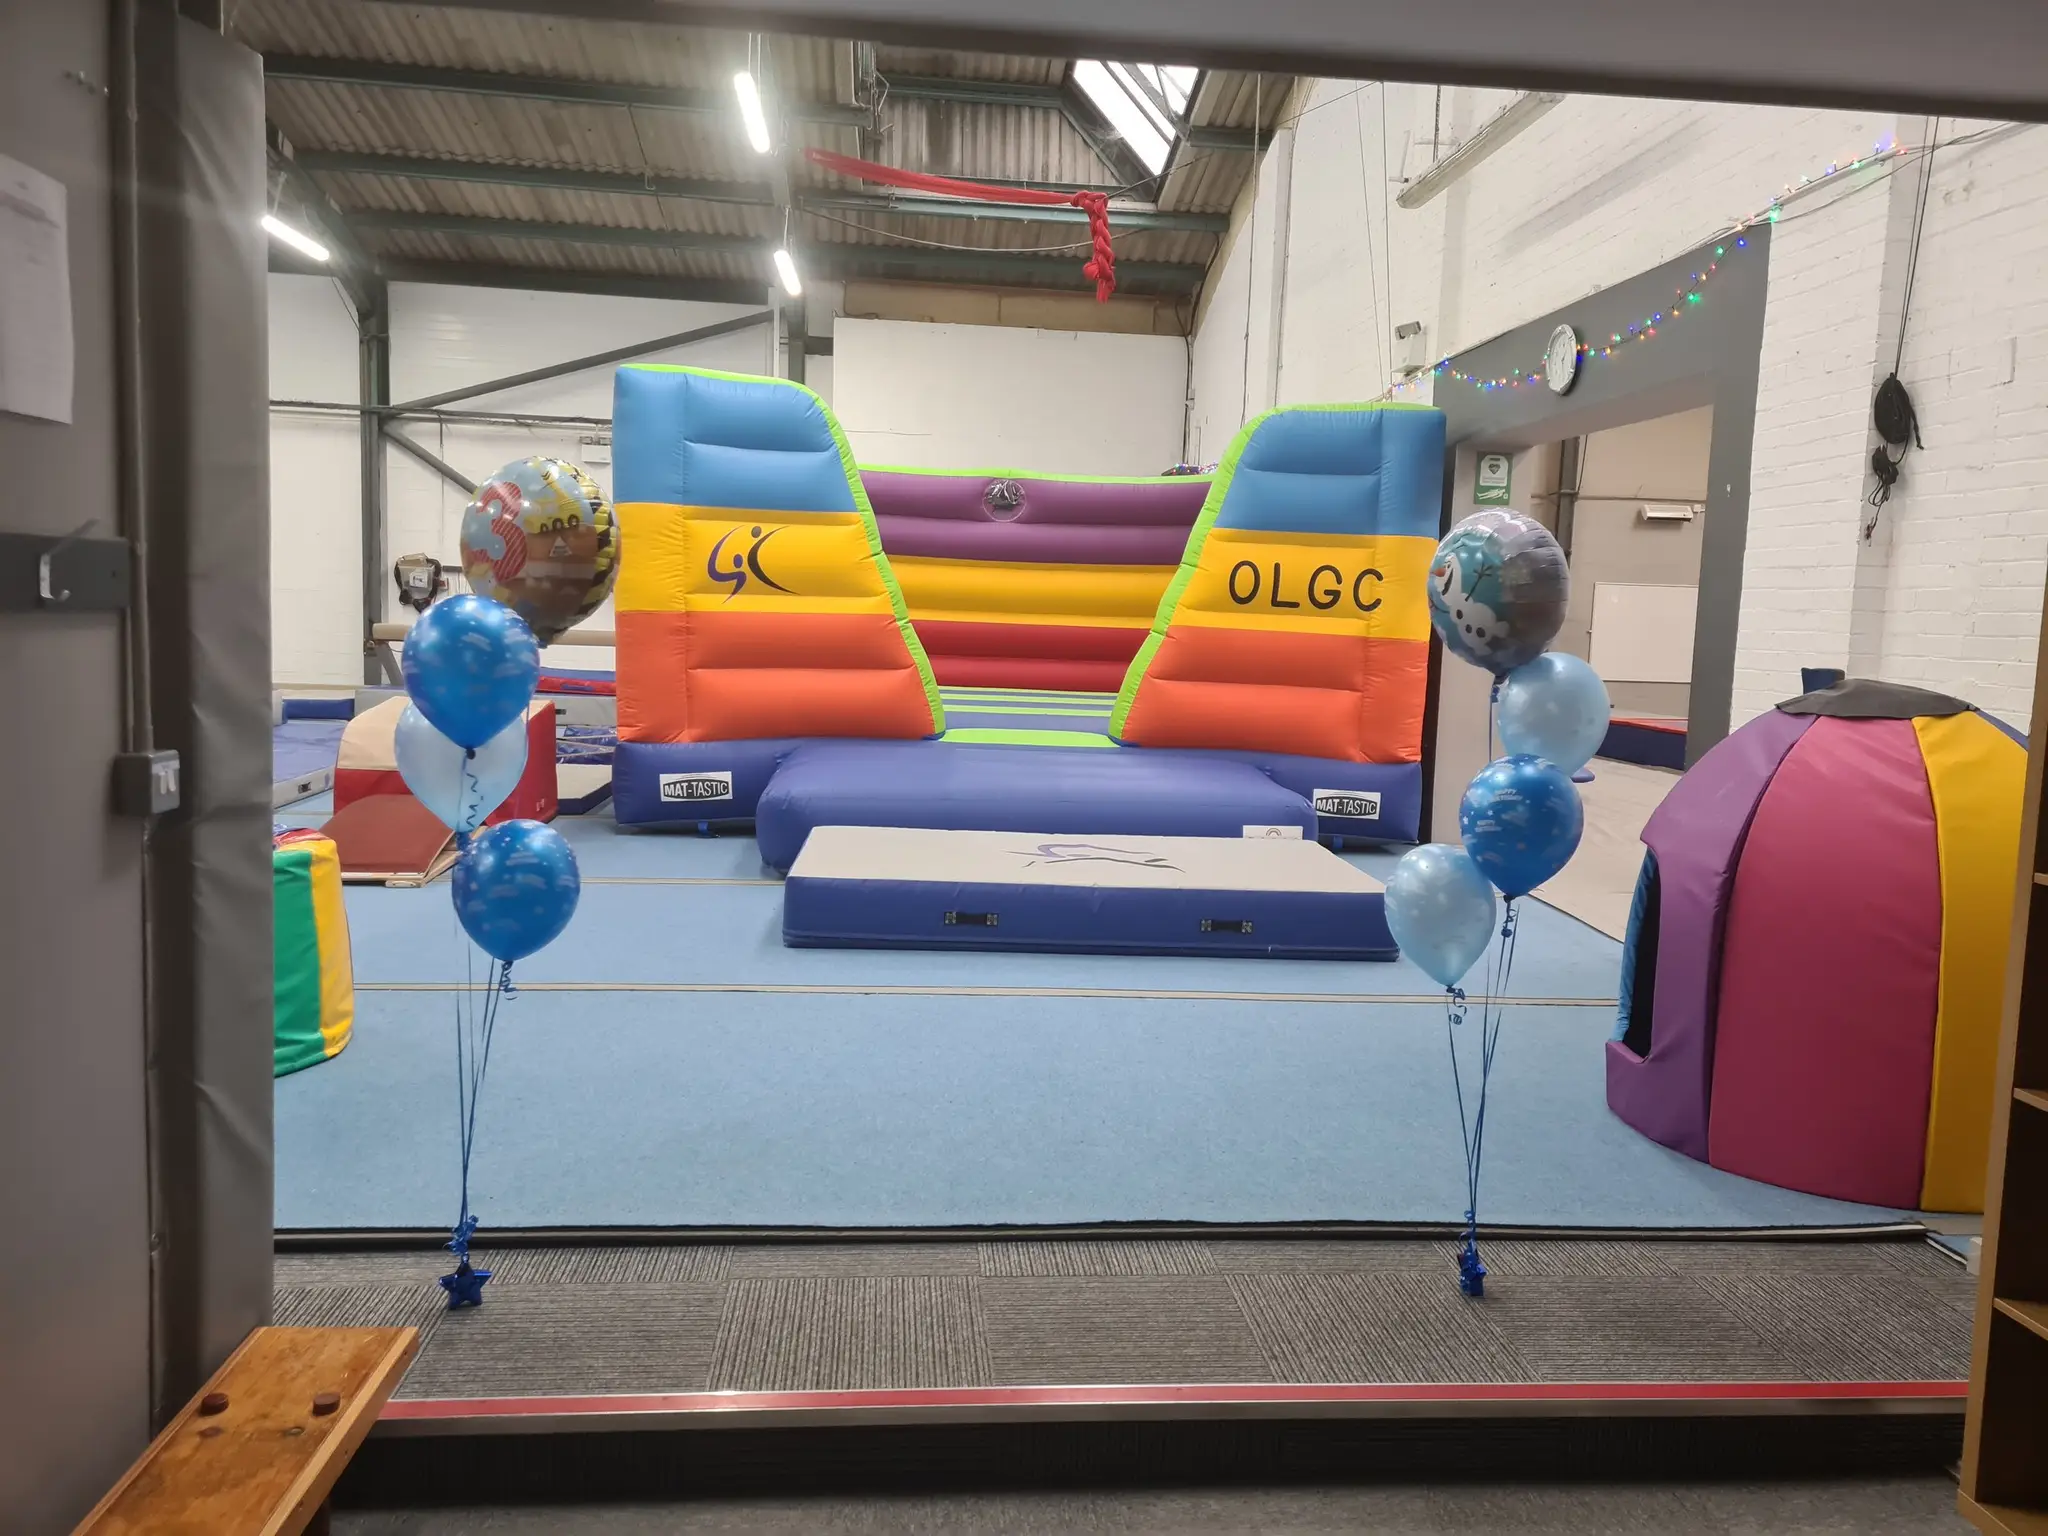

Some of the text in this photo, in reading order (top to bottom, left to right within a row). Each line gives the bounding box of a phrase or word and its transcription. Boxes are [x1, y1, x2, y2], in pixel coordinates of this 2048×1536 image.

[471, 481, 528, 581] 3
[1229, 560, 1384, 612] OLGC
[664, 781, 728, 797] MAT-TASTIC
[1316, 799, 1376, 814] MAT-TASTIC
